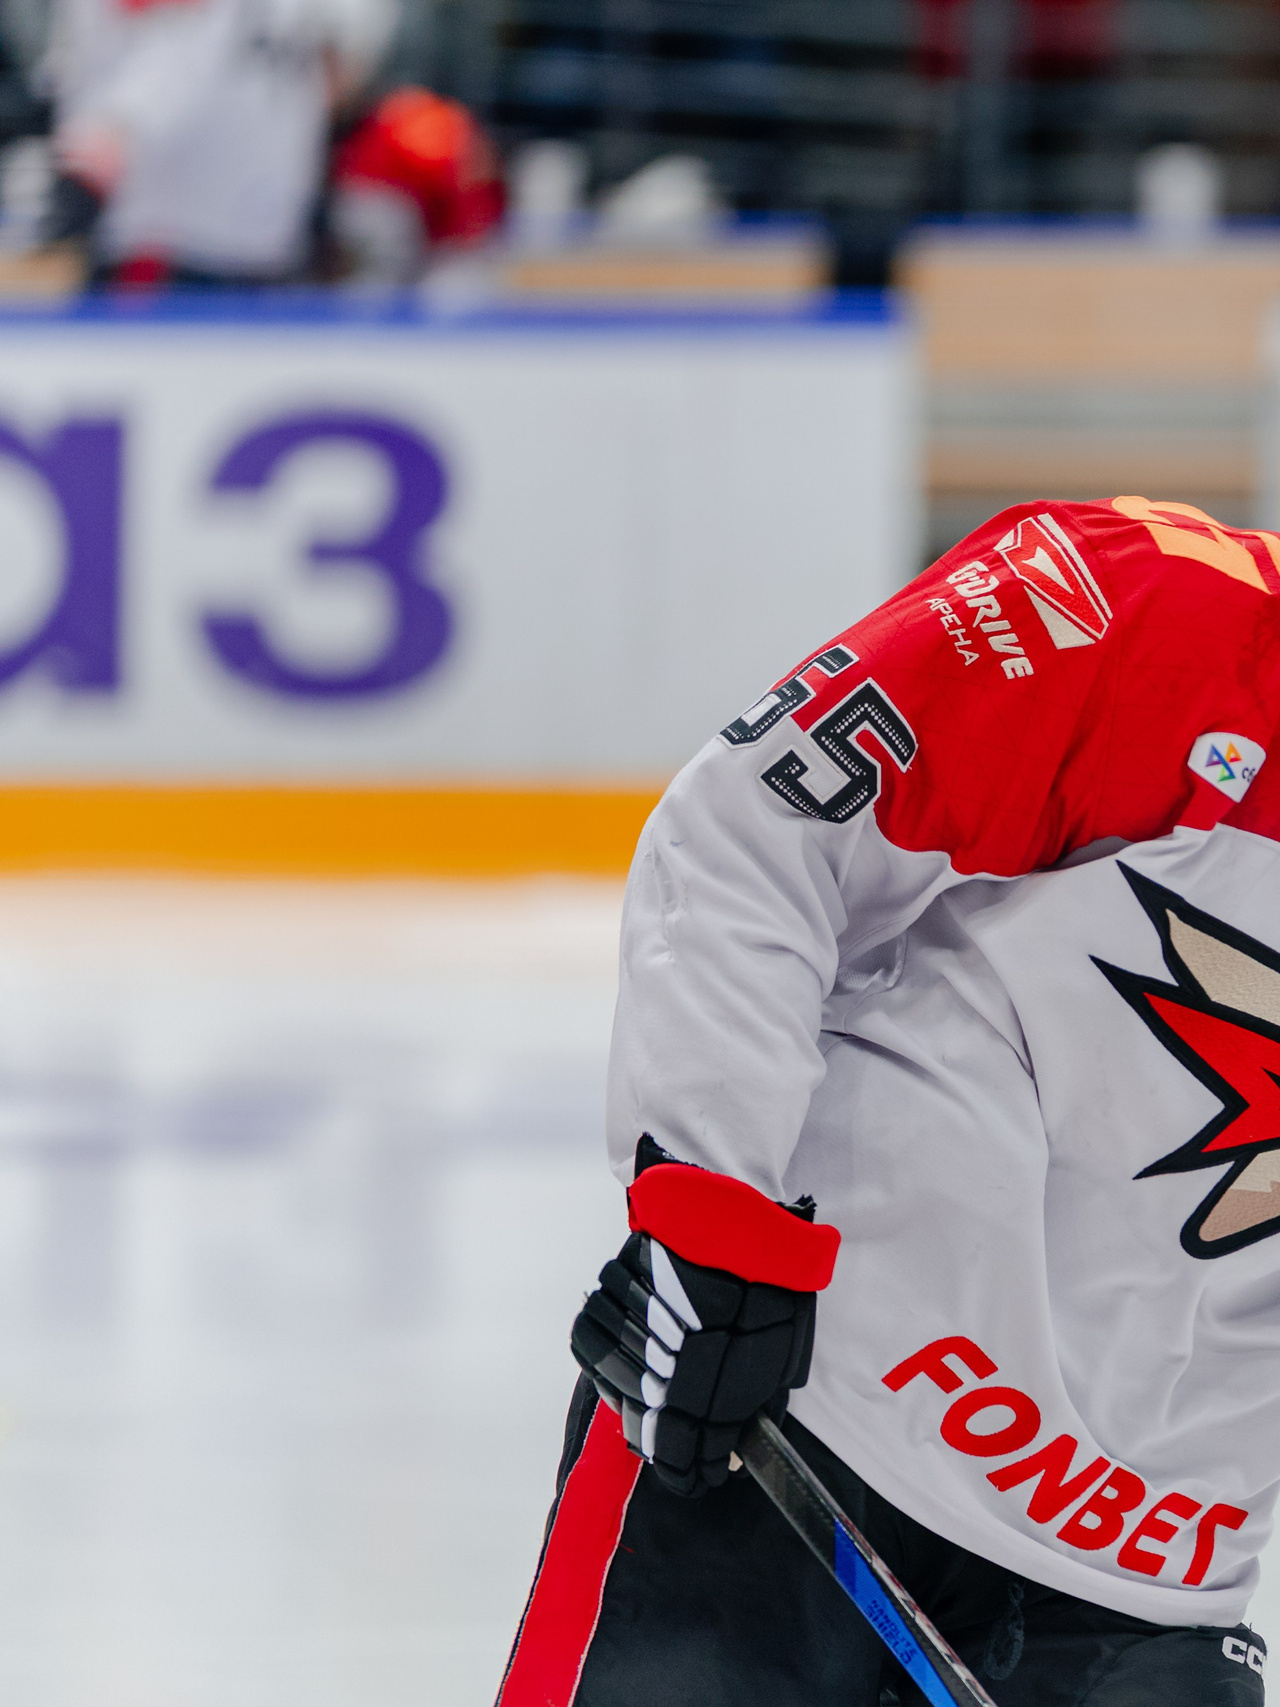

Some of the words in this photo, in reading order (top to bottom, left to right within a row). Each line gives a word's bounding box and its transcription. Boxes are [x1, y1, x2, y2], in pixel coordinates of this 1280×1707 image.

[718, 642, 918, 825] 65
[881, 1335, 1248, 1586] FONBET
[1221, 1635, 1267, 1676] CC
